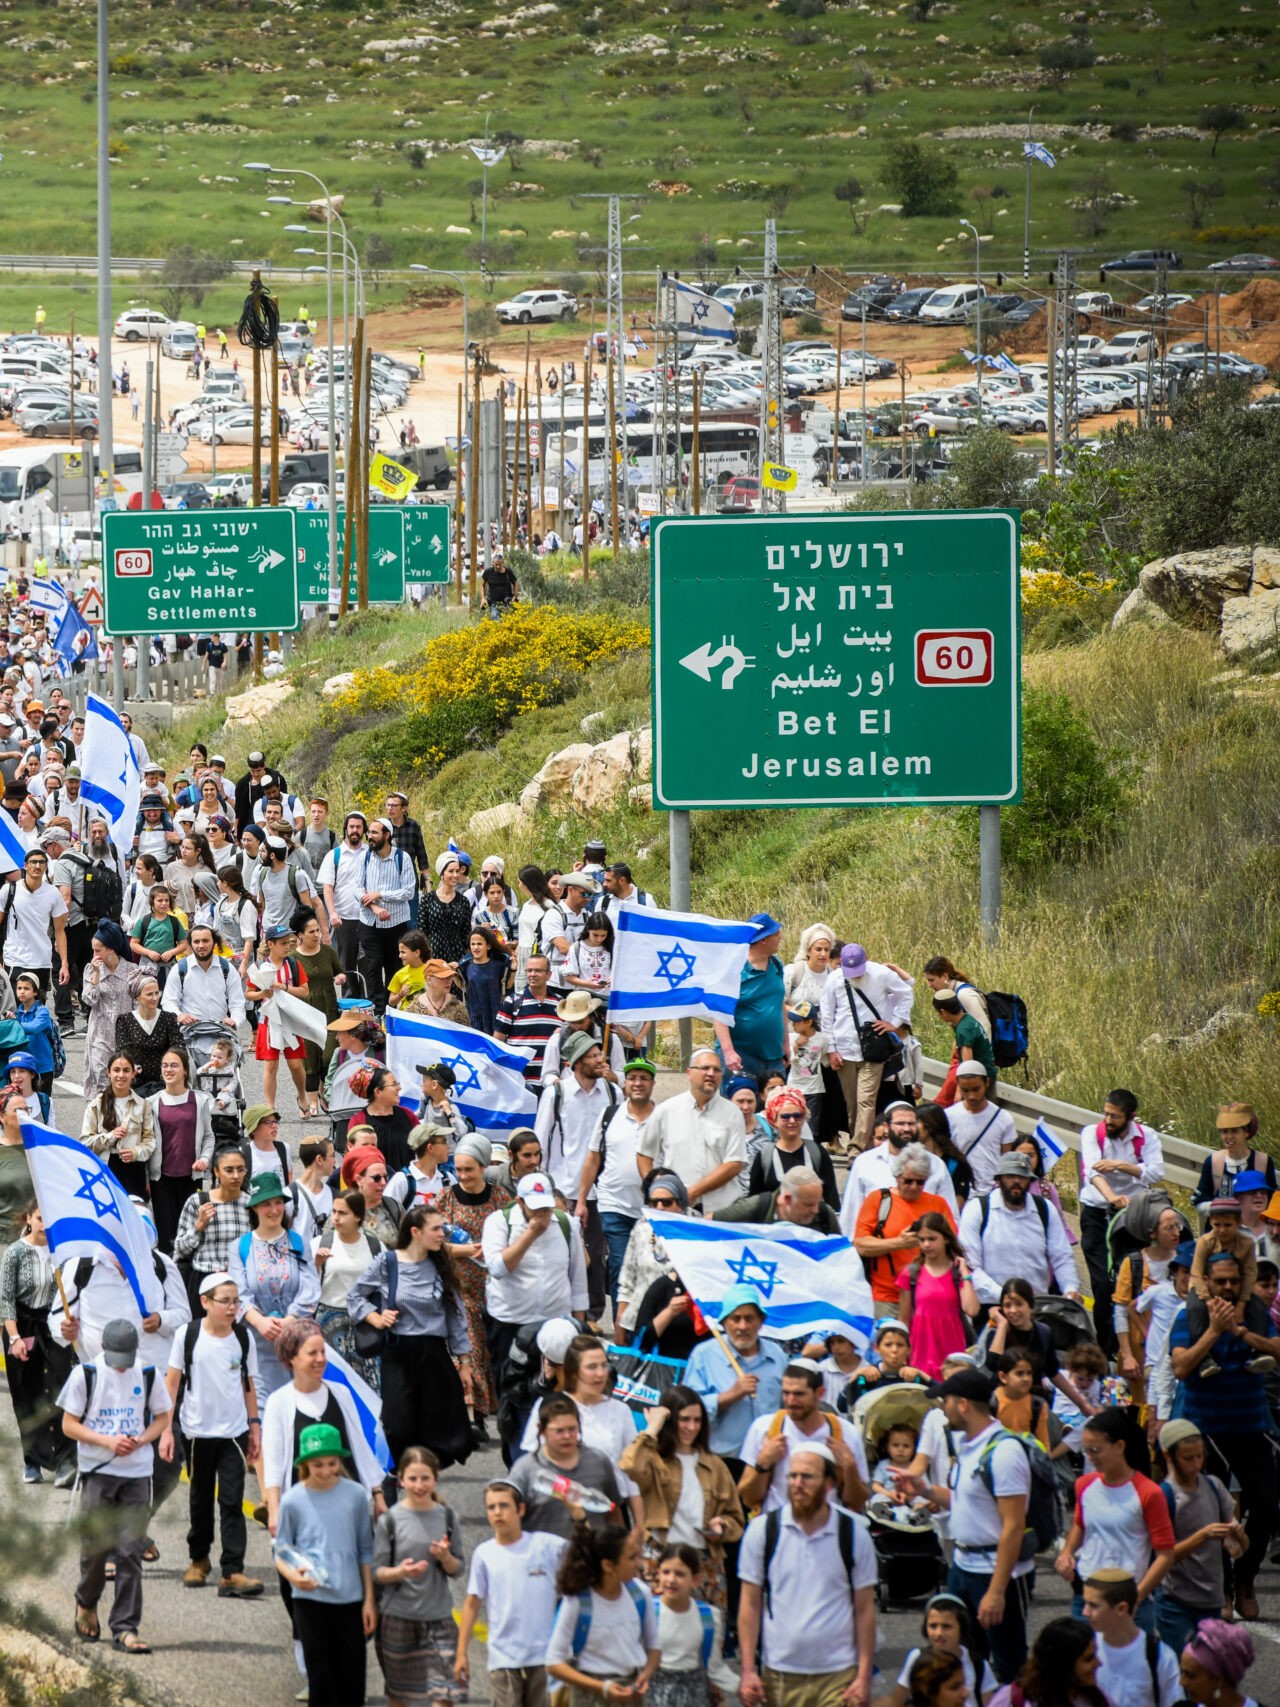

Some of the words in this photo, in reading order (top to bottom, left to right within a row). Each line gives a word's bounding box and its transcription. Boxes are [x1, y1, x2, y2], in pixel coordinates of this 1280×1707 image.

[309, 518, 328, 528] ורה
[416, 511, 428, 520] תל
[141, 524, 174, 538] ההר
[182, 523, 202, 538] גב
[212, 522, 258, 537] ישובי
[161, 541, 240, 558] مستوطنات
[765, 540, 904, 570] ירושלים
[124, 557, 144, 569] 60
[148, 586, 181, 600] Gav
[191, 584, 254, 599] HaHar-
[309, 586, 328, 595] Elo
[773, 582, 816, 611] אל
[838, 584, 894, 610] בית
[147, 605, 257, 621] Settlements
[776, 622, 821, 658] ايل
[843, 625, 893, 653] بيت
[935, 646, 973, 669] 60
[778, 711, 836, 736] Bet
[860, 709, 891, 734] El
[742, 751, 931, 778] Jerusalem
